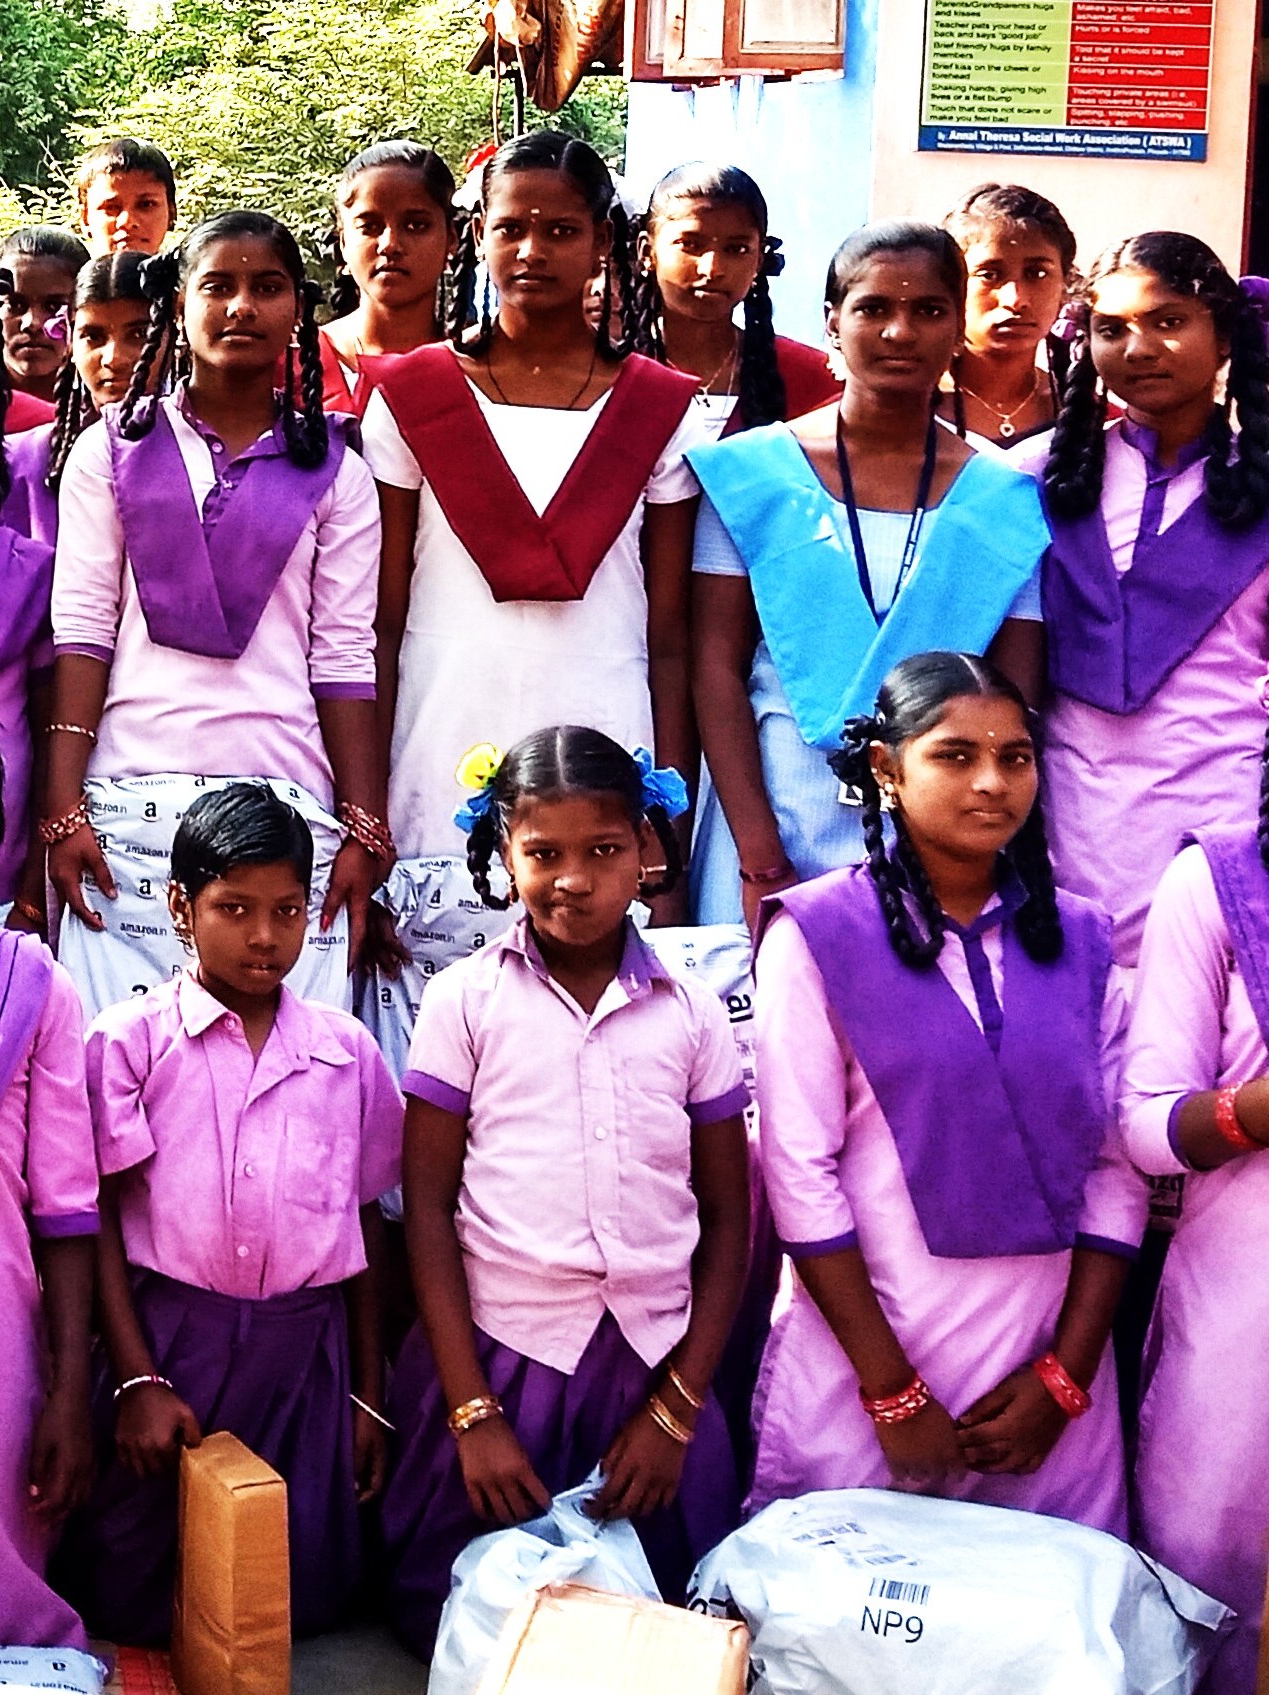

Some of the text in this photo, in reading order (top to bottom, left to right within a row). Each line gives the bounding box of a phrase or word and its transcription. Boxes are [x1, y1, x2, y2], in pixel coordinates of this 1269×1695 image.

[935, 20, 969, 28] Teacher
[956, 43, 987, 51] friendly
[990, 43, 1010, 51] hugs
[1026, 44, 1052, 53] family
[949, 130, 978, 141] Annal
[979, 131, 1020, 142] Theresa
[1022, 132, 1054, 143] Social
[1055, 133, 1081, 144] Work
[1082, 134, 1141, 145] Association
[861, 1606, 923, 1643] NP9
